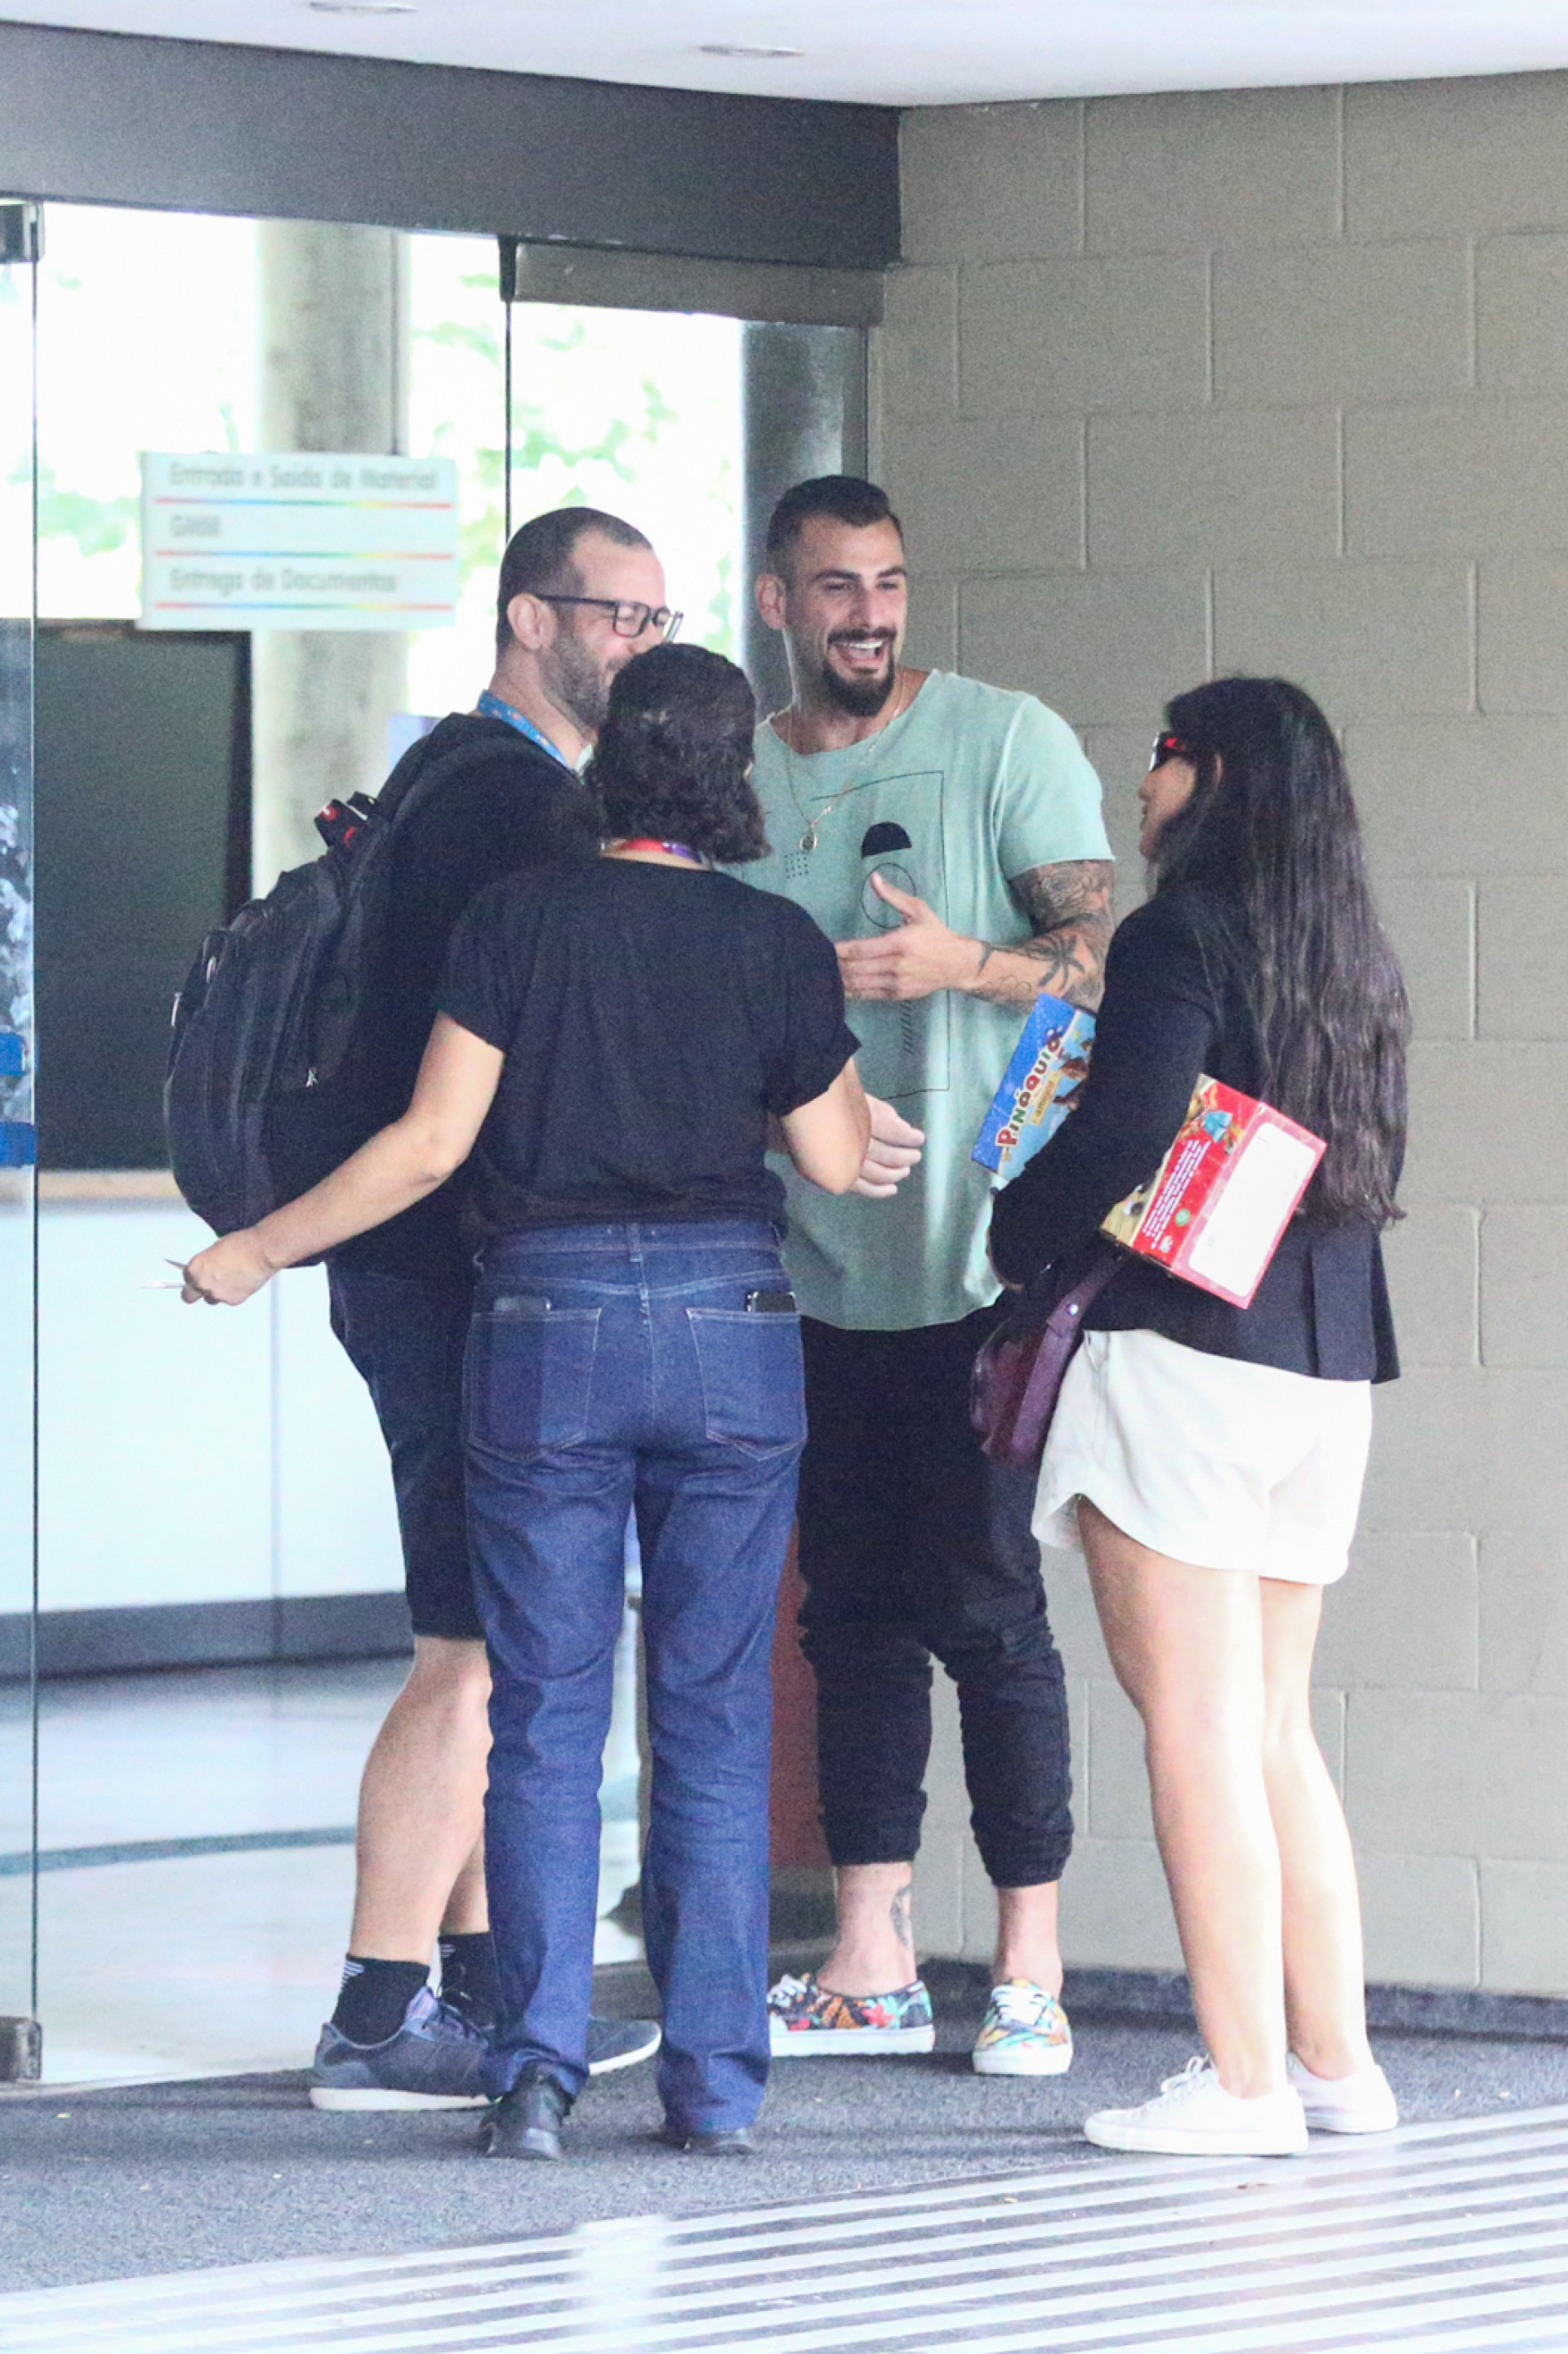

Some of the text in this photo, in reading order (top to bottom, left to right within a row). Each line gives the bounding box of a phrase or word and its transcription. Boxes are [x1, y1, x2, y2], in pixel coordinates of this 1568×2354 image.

[170, 463, 243, 486] Entrada
[330, 467, 351, 488] de
[360, 466, 437, 490] Material
[252, 569, 275, 591] de
